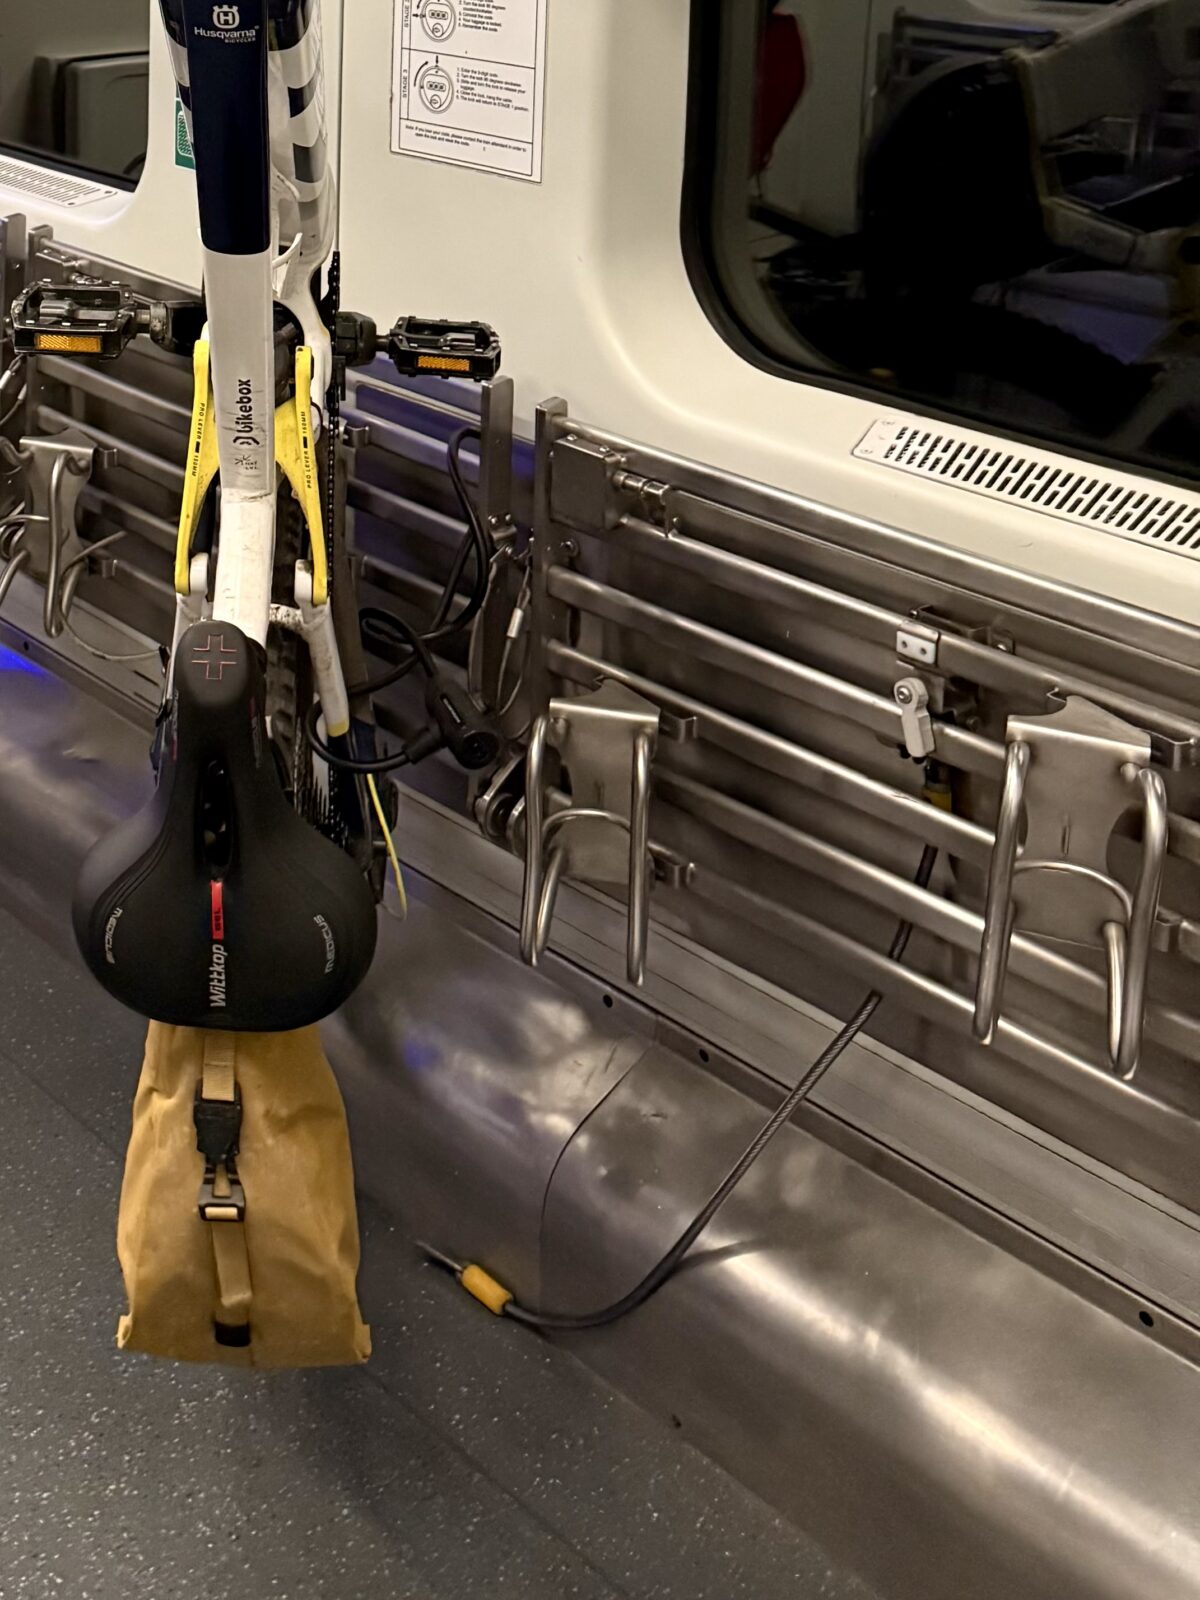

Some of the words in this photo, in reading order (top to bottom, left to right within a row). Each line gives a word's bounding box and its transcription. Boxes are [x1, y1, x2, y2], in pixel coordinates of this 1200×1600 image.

[194, 26, 256, 39] Husqvarna
[236, 379, 252, 434] bikebox
[209, 943, 229, 1008] Wittkop
